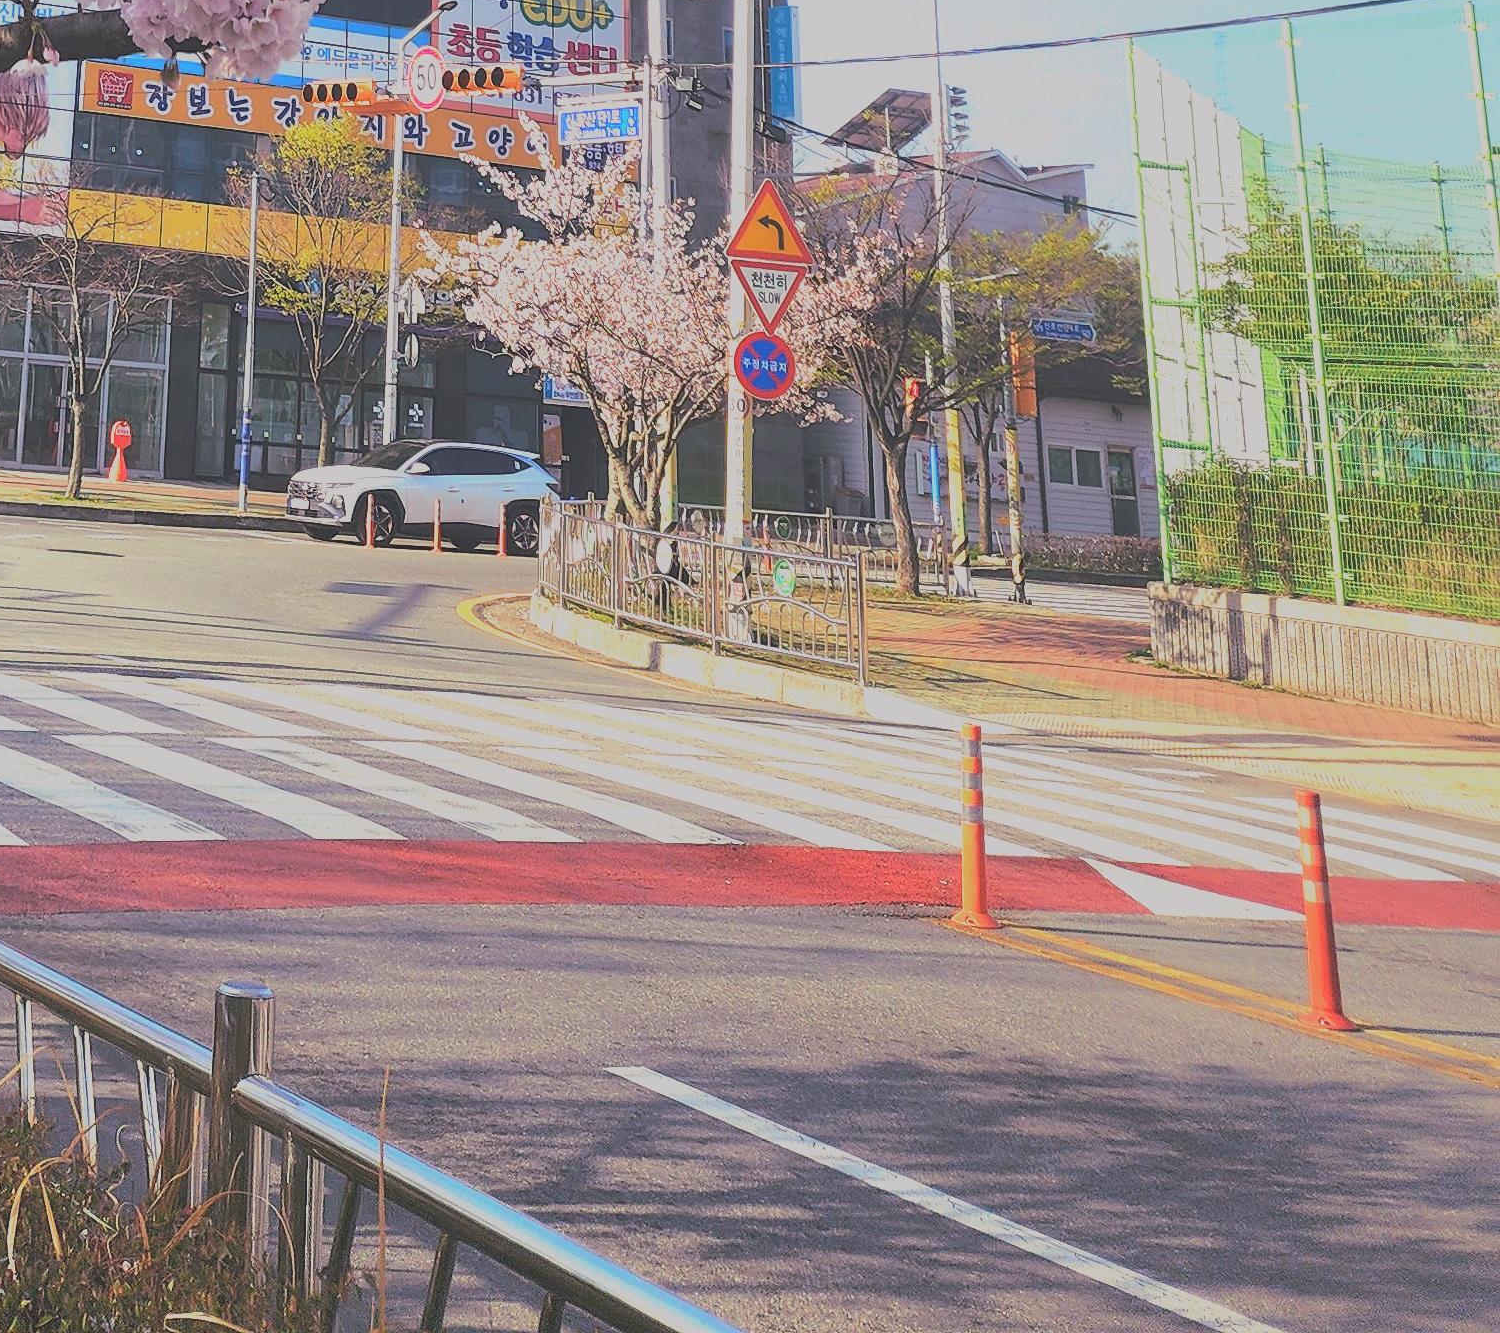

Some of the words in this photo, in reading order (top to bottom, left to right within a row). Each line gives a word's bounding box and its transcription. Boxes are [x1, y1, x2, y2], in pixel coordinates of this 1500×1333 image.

[446, 23, 502, 64] 초등
[416, 63, 437, 91] 50
[751, 271, 788, 291] 천천히
[757, 290, 782, 305] SLOW
[742, 355, 788, 374] 주정차금지
